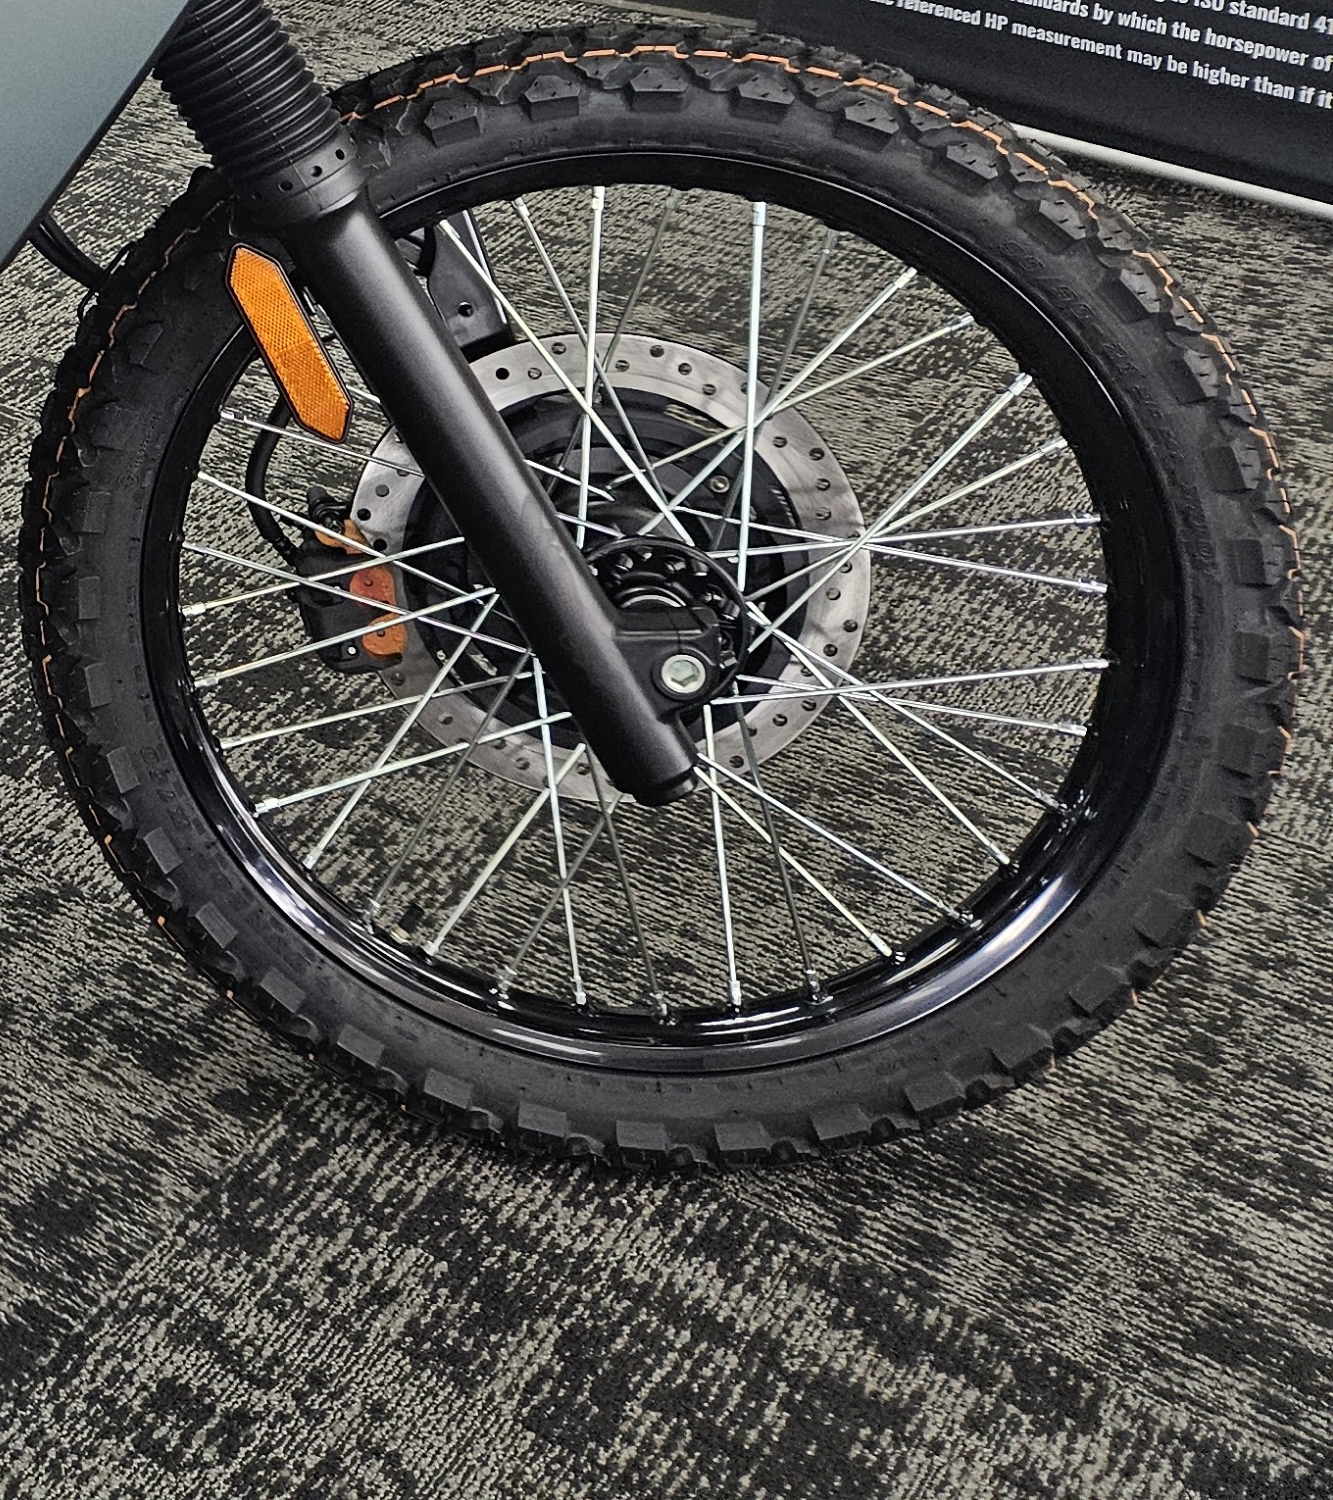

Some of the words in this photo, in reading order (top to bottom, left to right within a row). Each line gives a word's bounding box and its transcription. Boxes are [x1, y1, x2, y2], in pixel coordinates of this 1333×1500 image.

[1092, 2, 1114, 26] by
[1117, 11, 1167, 35] which
[1171, 20, 1201, 43] the
[1205, 27, 1309, 66] horsepower
[1311, 54, 1333, 73] of
[1228, 0, 1310, 30] standard
[984, 12, 1009, 31] HP
[1011, 22, 1123, 60] measurement
[1127, 48, 1163, 71] may
[1167, 54, 1188, 75] be
[1192, 60, 1250, 85] higher
[1254, 75, 1295, 100] than
[1298, 85, 1316, 104] if
[1317, 89, 1333, 110] it
